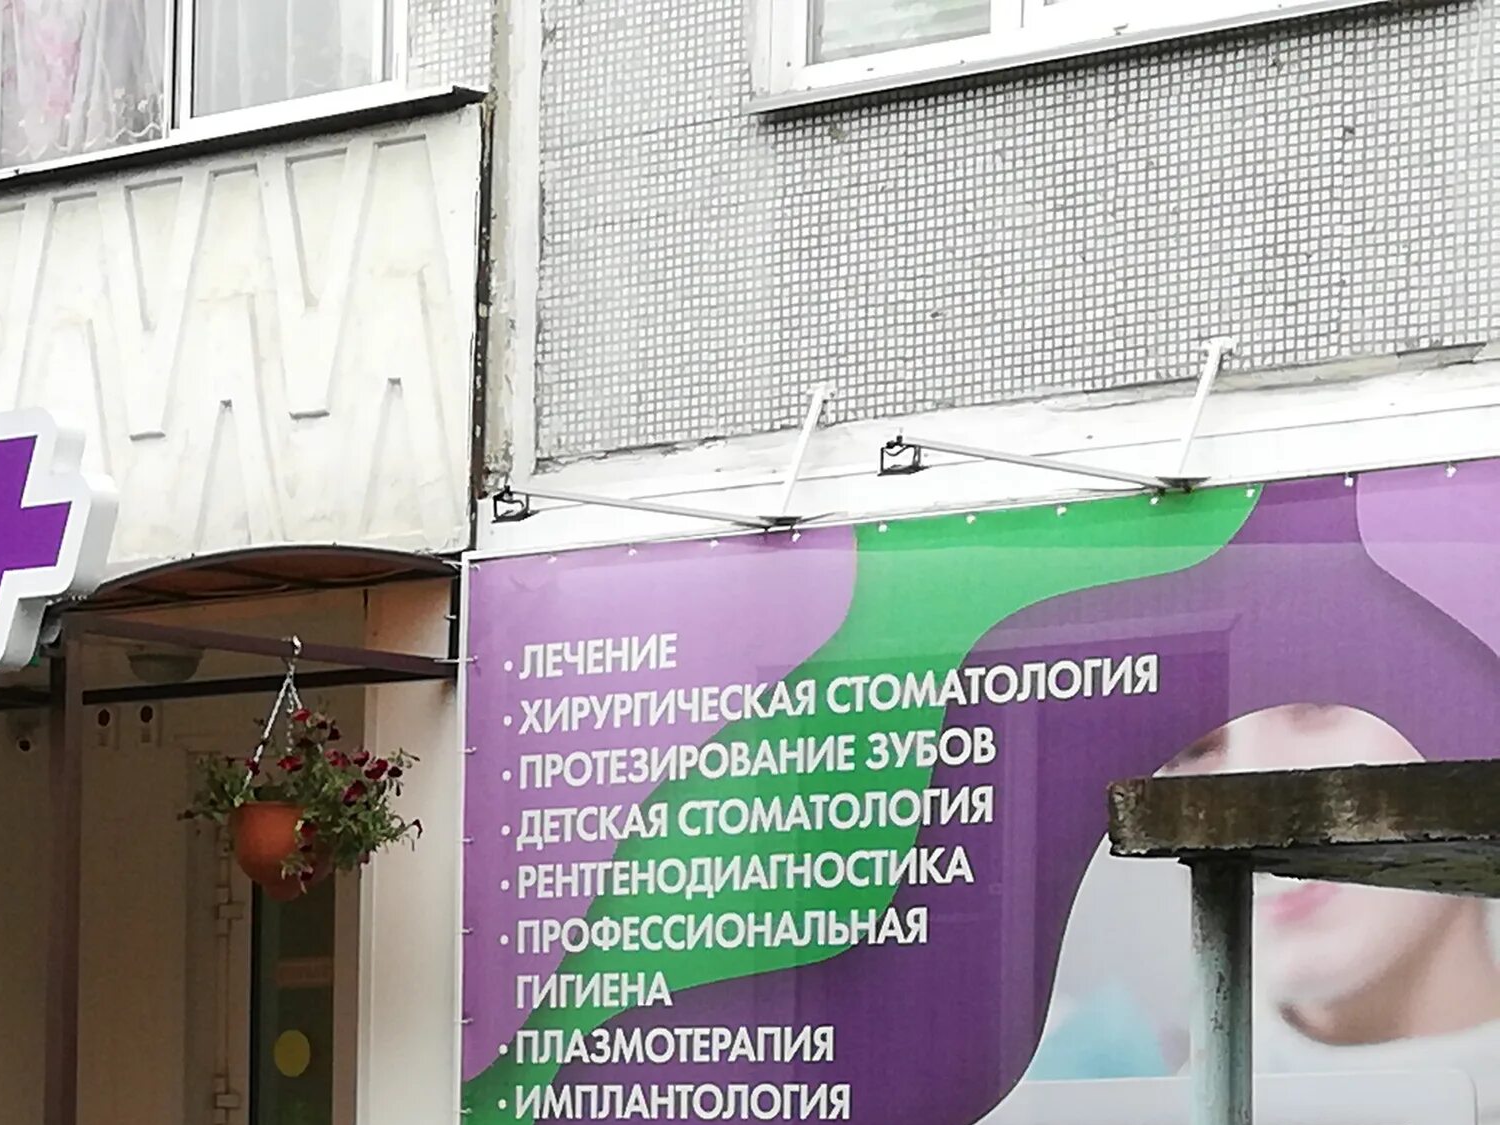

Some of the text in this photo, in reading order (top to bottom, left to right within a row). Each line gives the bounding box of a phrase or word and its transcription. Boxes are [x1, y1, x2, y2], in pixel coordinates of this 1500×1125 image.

[519, 633, 677, 680] ЛЕЧЕНИЕ
[519, 654, 1159, 734] ХИРУРГИЧЕСКАЯ СТОМАТОЛОГИЯ
[519, 727, 996, 789] ПРОТЕЗИРОВАНИЕ ЗУБОВ
[516, 786, 994, 851] ДЕТСКАЯ СТОМАТОЛОГИЯ
[517, 847, 973, 899] РЕНТГЕНОДИАГНОСТИКА
[516, 907, 929, 954] ПРОФЕССИОНАЛЬНАЯ
[516, 972, 673, 1009] ГИГИЕНА
[514, 1026, 834, 1065] ПЛАЗМОТЕРАПИЯ
[514, 1083, 851, 1120] ИМПЛАНТОЛОГИЯ
